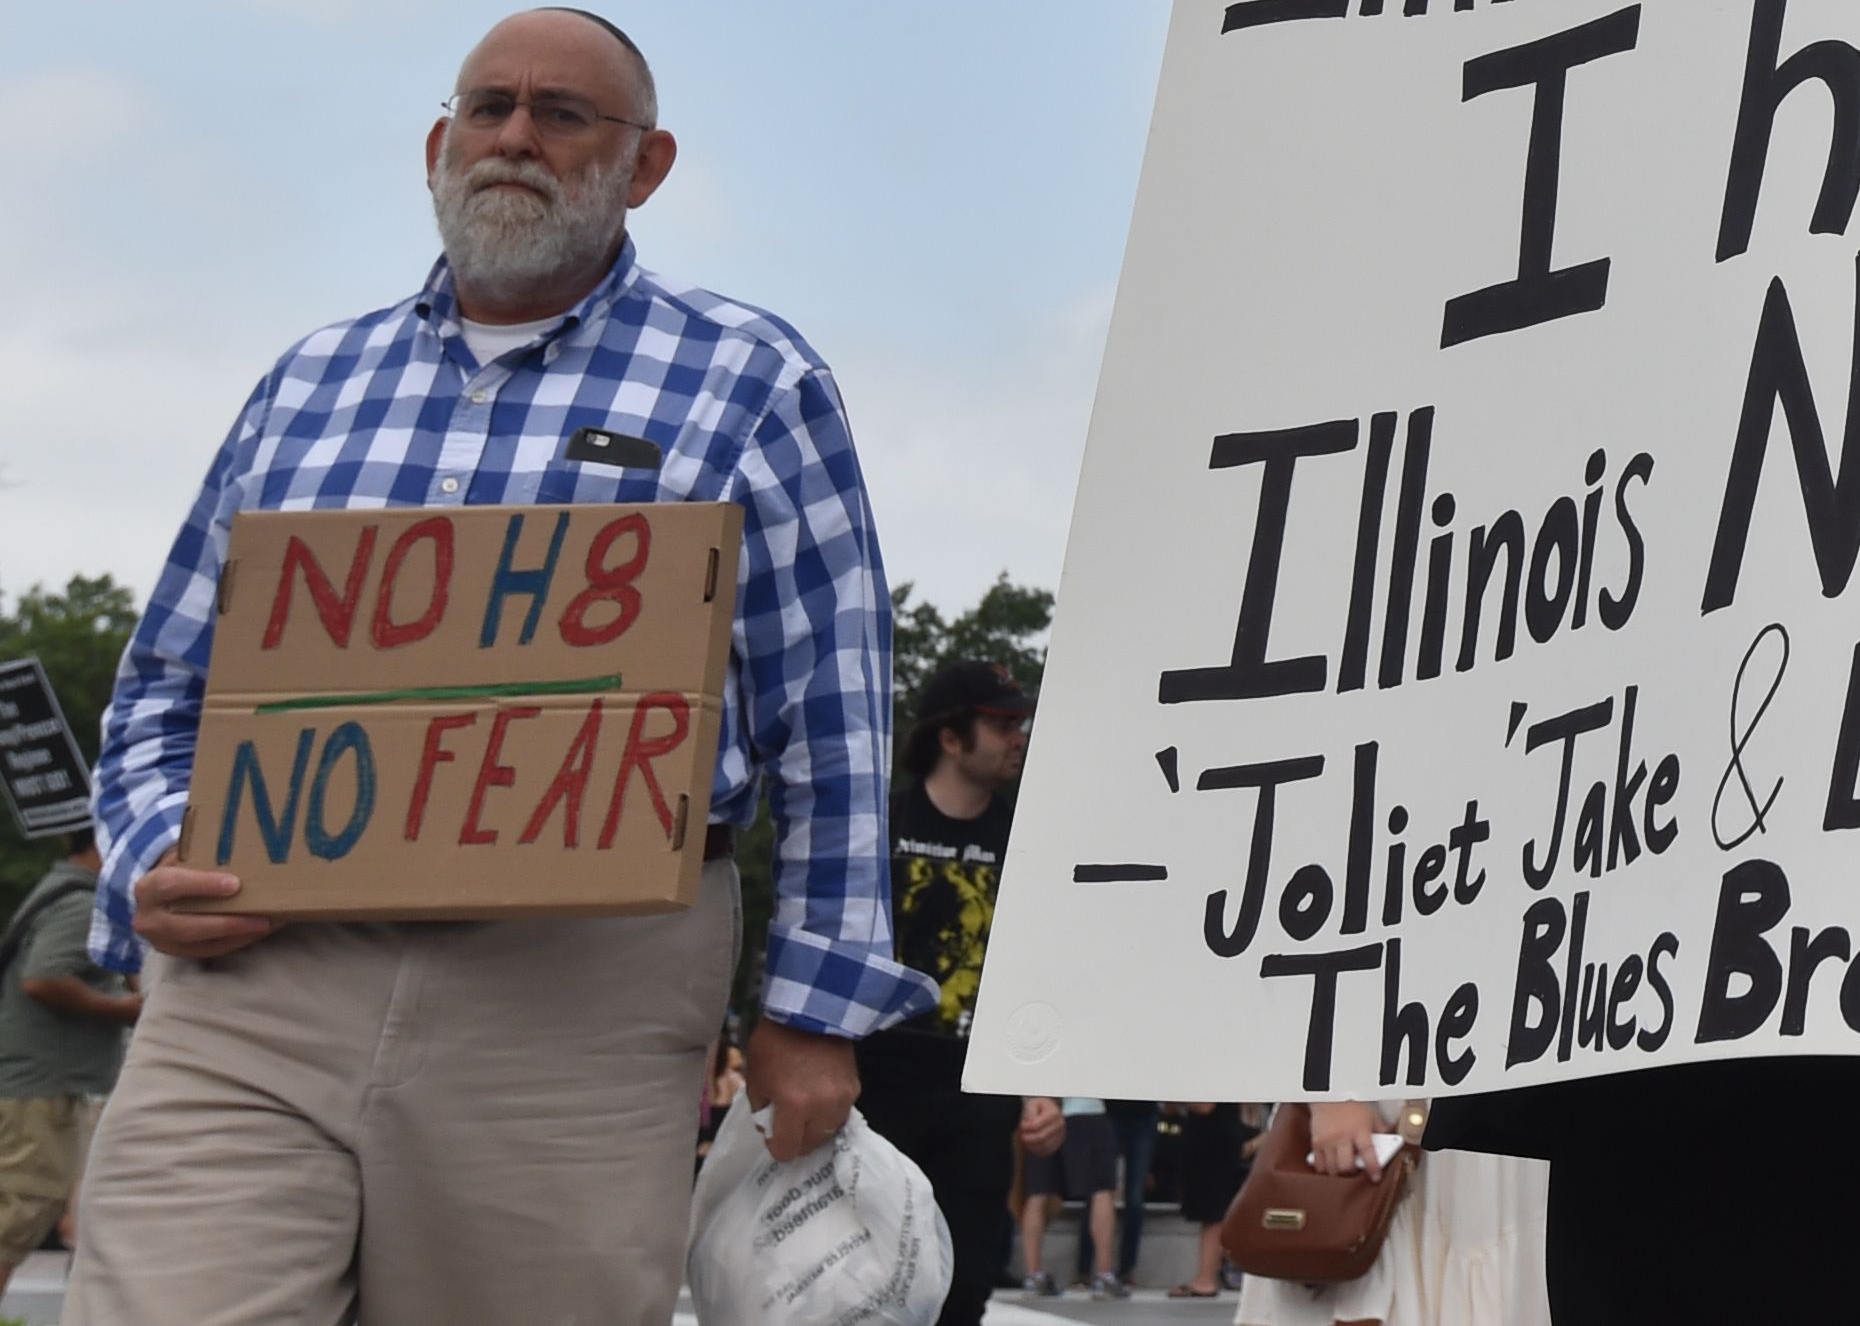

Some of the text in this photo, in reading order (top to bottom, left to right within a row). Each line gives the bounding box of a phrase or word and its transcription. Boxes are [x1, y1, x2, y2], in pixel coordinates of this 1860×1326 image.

[1440, 3, 1641, 349] I
[261, 511, 652, 651] NO H8
[1159, 406, 1654, 704] Illinois
[216, 691, 689, 866] NO FEAR
[1710, 623, 1789, 852] &
[1260, 938, 1478, 1091] The
[1505, 891, 1679, 1071] Blues
